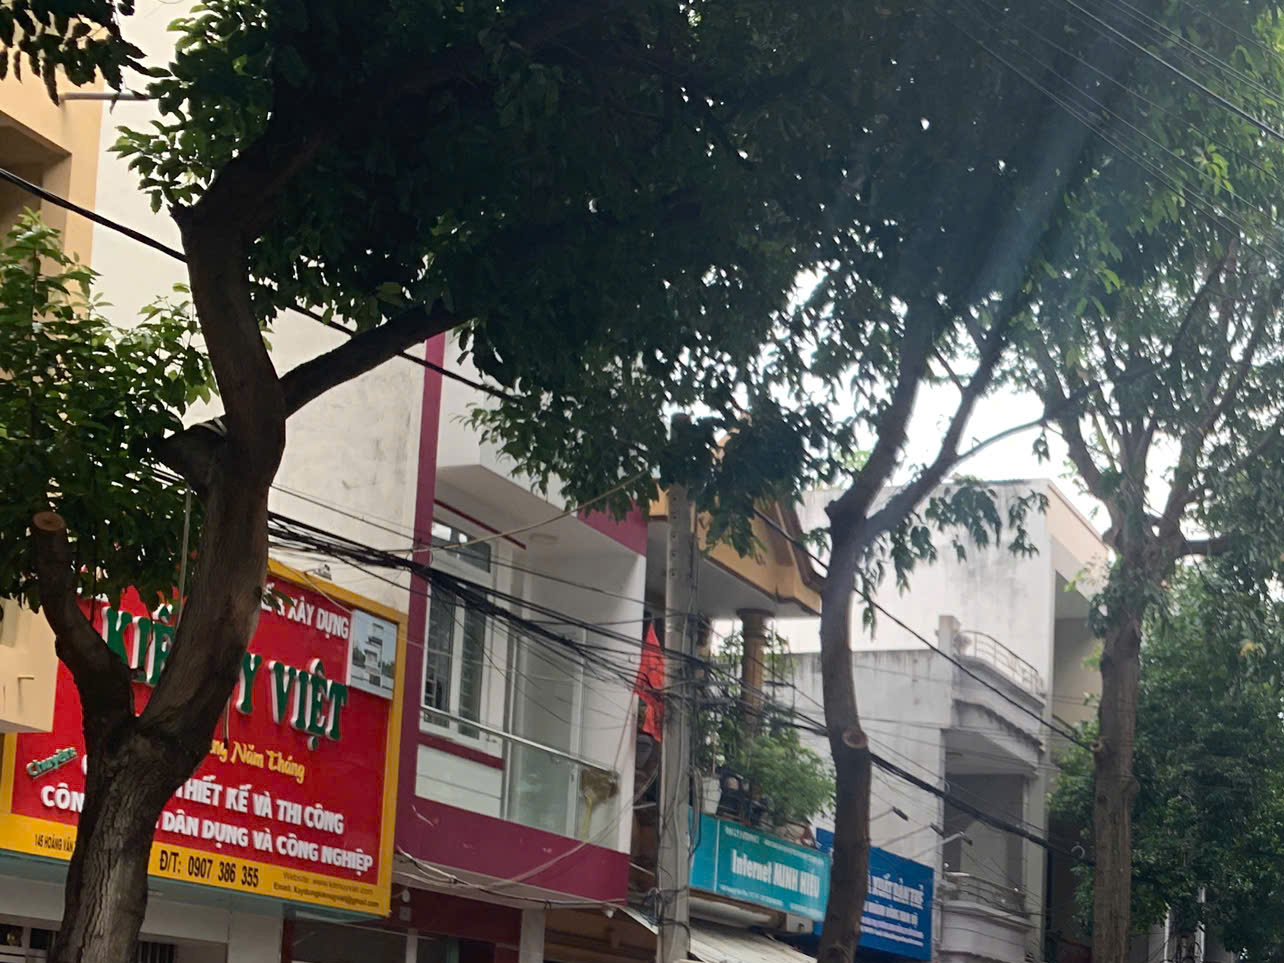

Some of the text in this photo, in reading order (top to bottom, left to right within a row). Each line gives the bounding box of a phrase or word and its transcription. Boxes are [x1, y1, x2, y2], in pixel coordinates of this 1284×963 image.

[268, 658, 349, 752] VIỆT
[226, 784, 252, 813] KẾ
[253, 791, 273, 818] VÀ
[276, 800, 302, 825] THI
[303, 804, 344, 835] CÔNG
[160, 850, 259, 887] Đ/T: 0907 386 355
[162, 809, 373, 877] DÂN DỤNG VÀ CÔNG NGHIỆP
[731, 848, 773, 886] Internet
